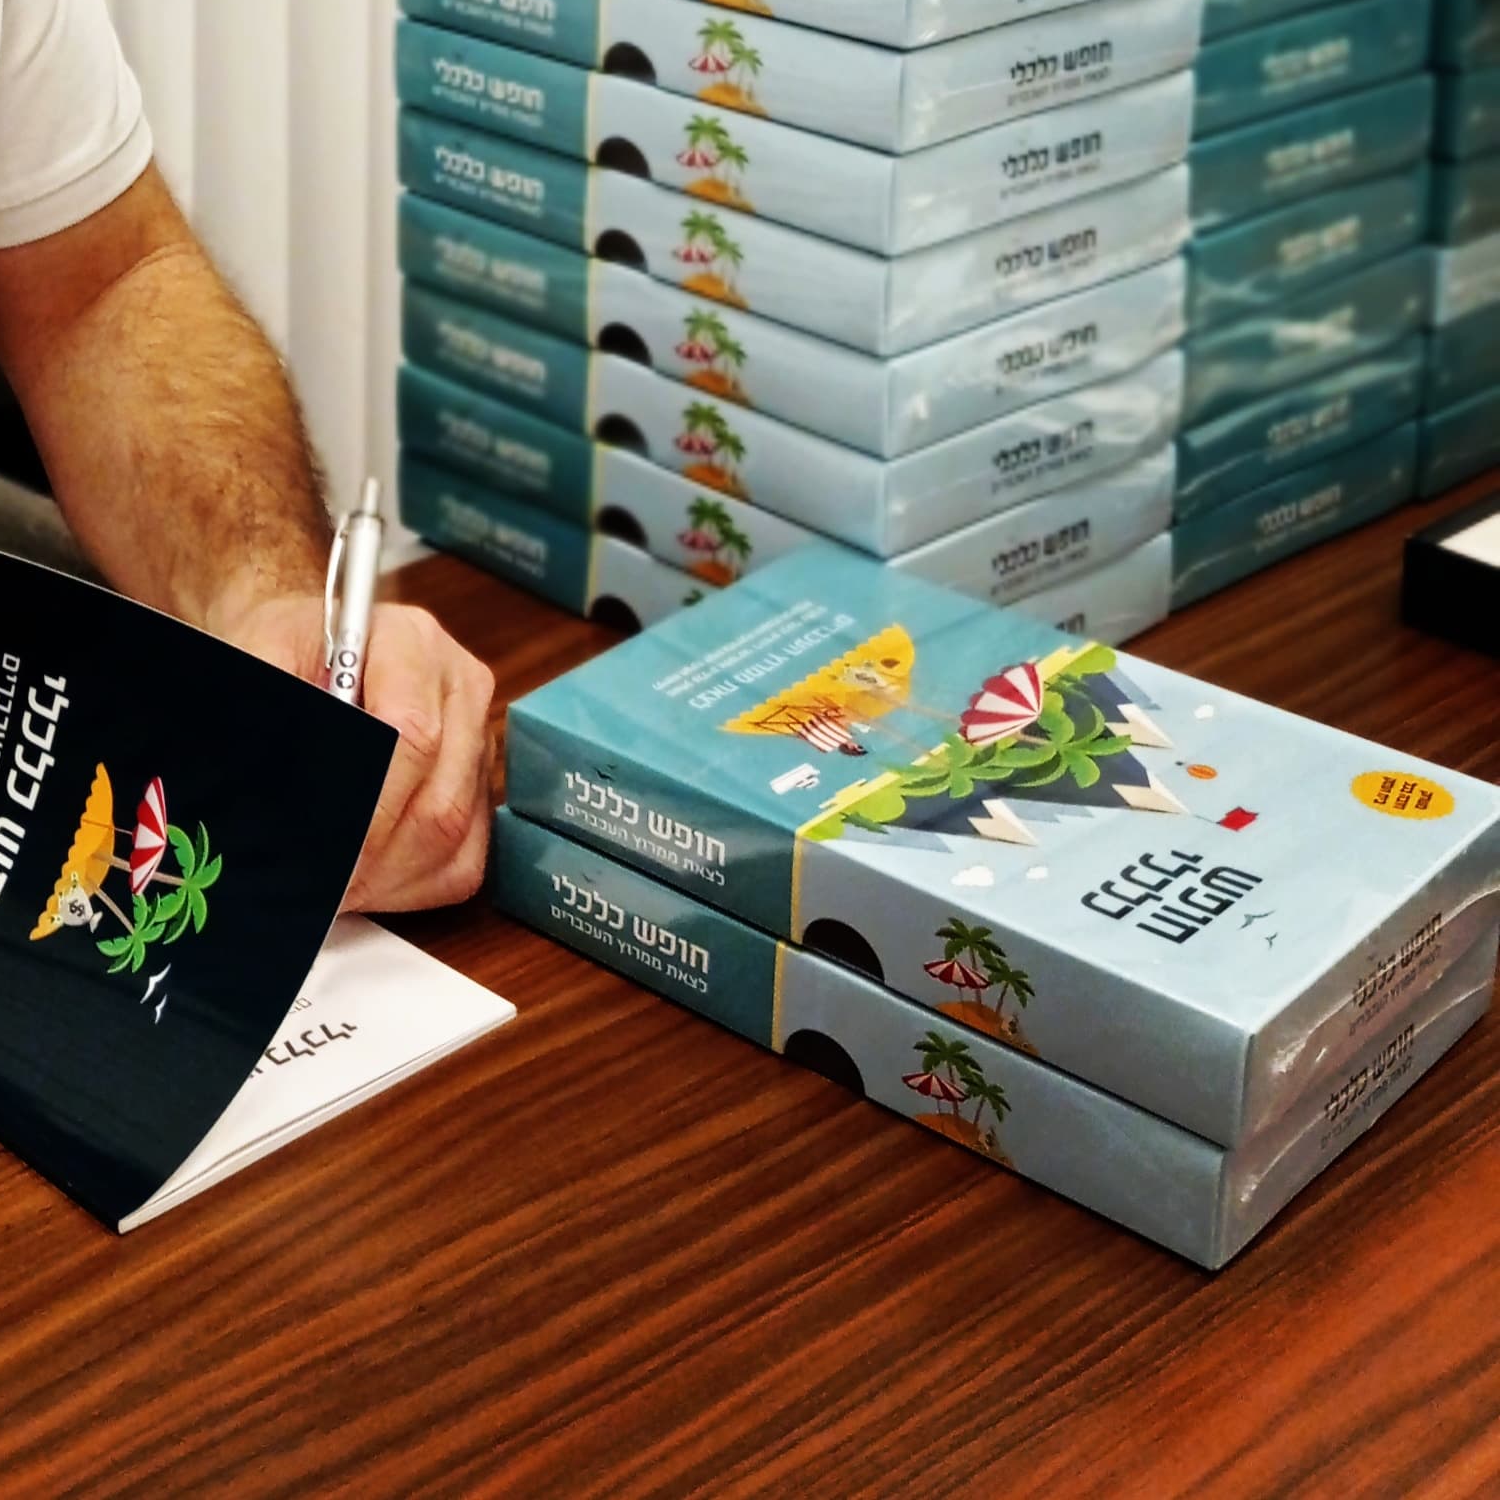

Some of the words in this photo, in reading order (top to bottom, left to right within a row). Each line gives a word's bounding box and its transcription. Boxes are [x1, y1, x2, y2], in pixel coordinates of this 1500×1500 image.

[7, 675, 69, 810] כלכלי
[565, 772, 639, 825] כלכלי
[565, 802, 629, 841] העכברים
[634, 834, 679, 865] ממרוץ
[649, 811, 725, 866] חופש
[683, 856, 725, 886] לצאת
[1080, 850, 1203, 920] כלכלי
[551, 874, 625, 929] כלכלי
[551, 904, 614, 947] העכברים
[1136, 865, 1263, 943] חופש
[617, 939, 662, 972] ממרוץ
[632, 915, 709, 975] חופש
[667, 963, 708, 993] לצאת
[264, 1023, 358, 1066] כלכלי
